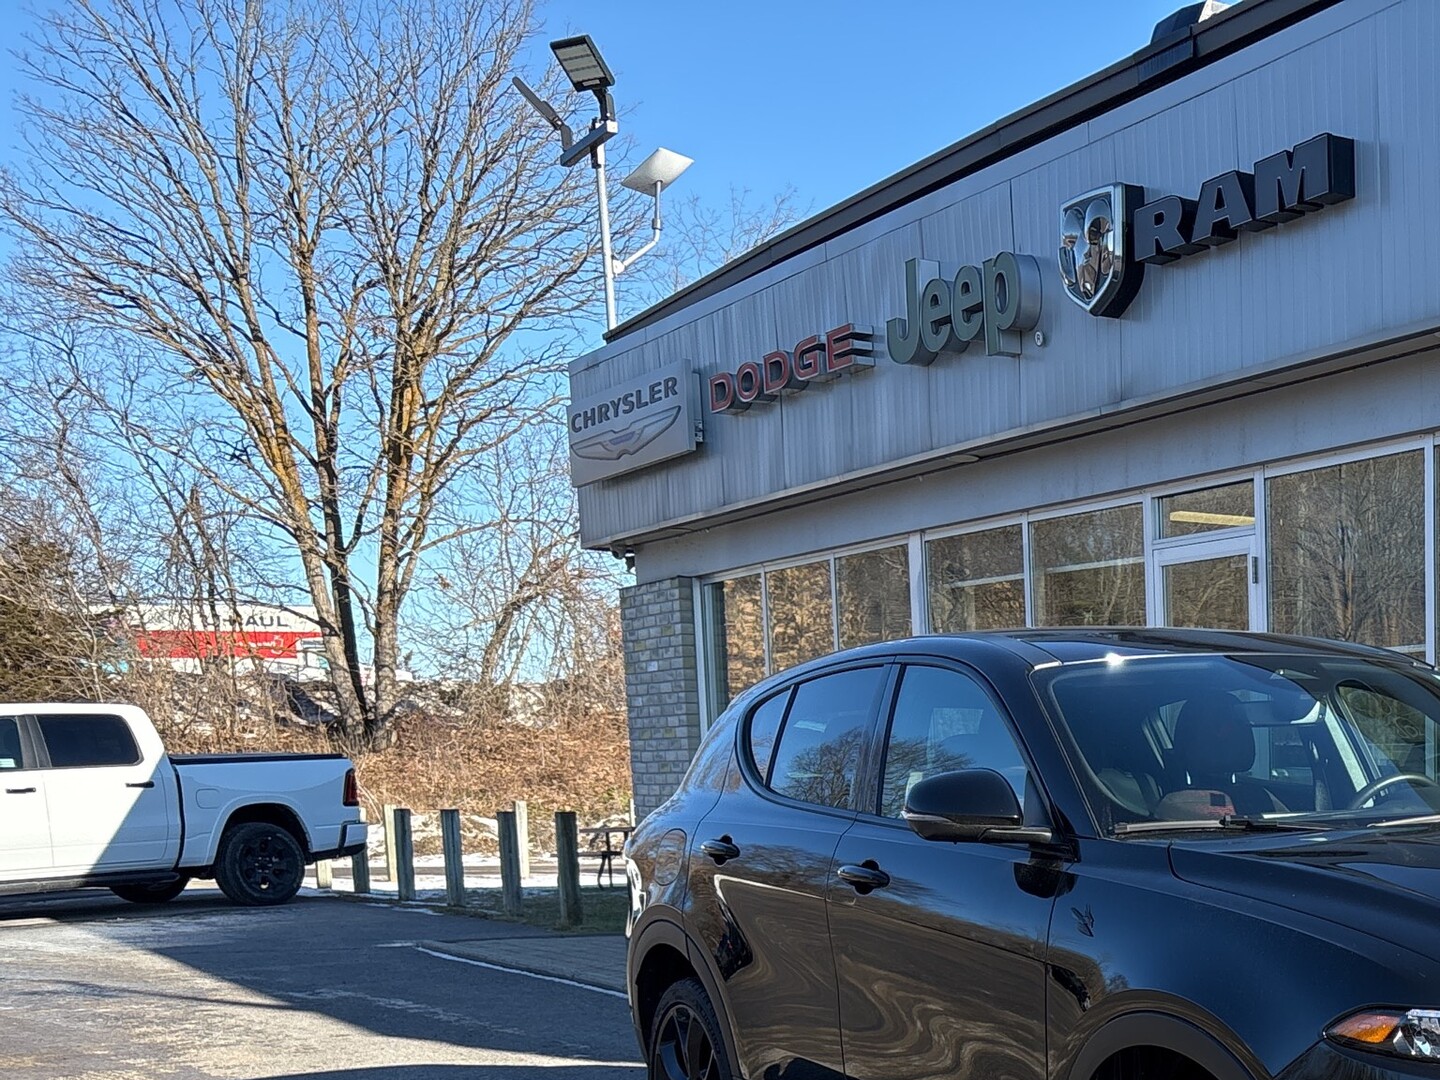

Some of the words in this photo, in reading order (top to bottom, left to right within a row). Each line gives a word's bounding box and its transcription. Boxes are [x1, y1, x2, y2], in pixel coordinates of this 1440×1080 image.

[1134, 134, 1331, 261] RAM
[886, 251, 1022, 365] Jeep
[571, 376, 679, 434] CHRYSLER
[708, 323, 855, 413] DODGE
